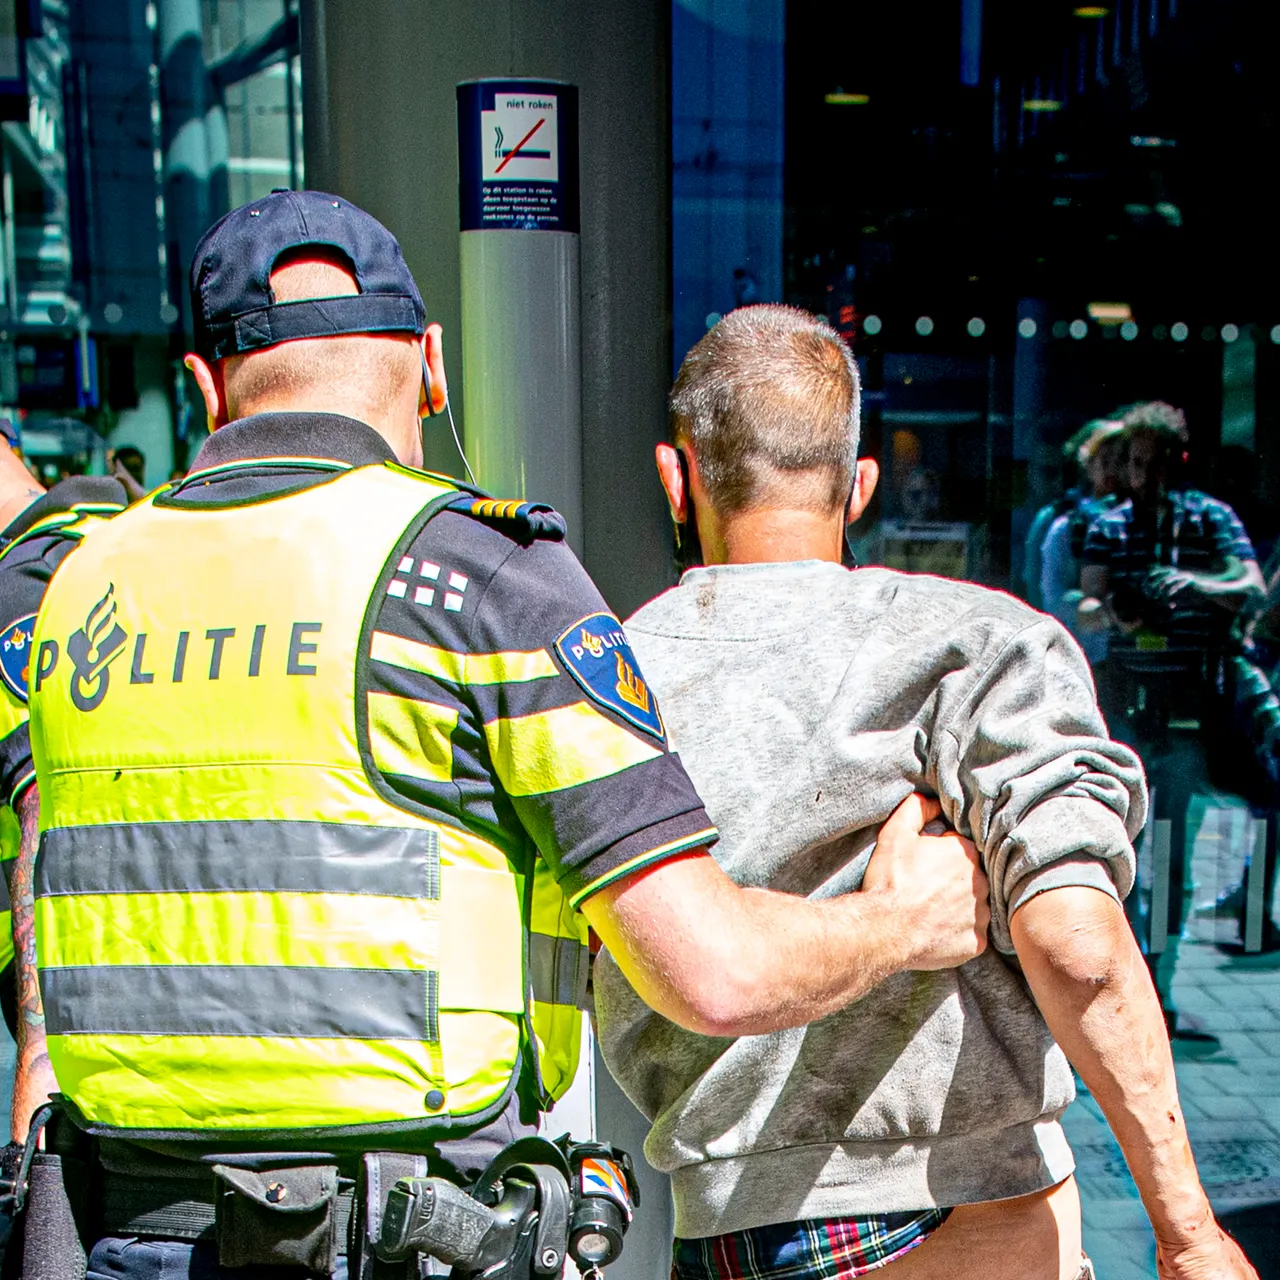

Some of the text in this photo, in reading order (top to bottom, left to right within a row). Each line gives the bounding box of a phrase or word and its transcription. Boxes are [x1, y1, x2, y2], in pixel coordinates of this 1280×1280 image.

[507, 98, 553, 110] niet roken
[570, 632, 633, 661] POLITI
[35, 622, 321, 712] POLITIE
